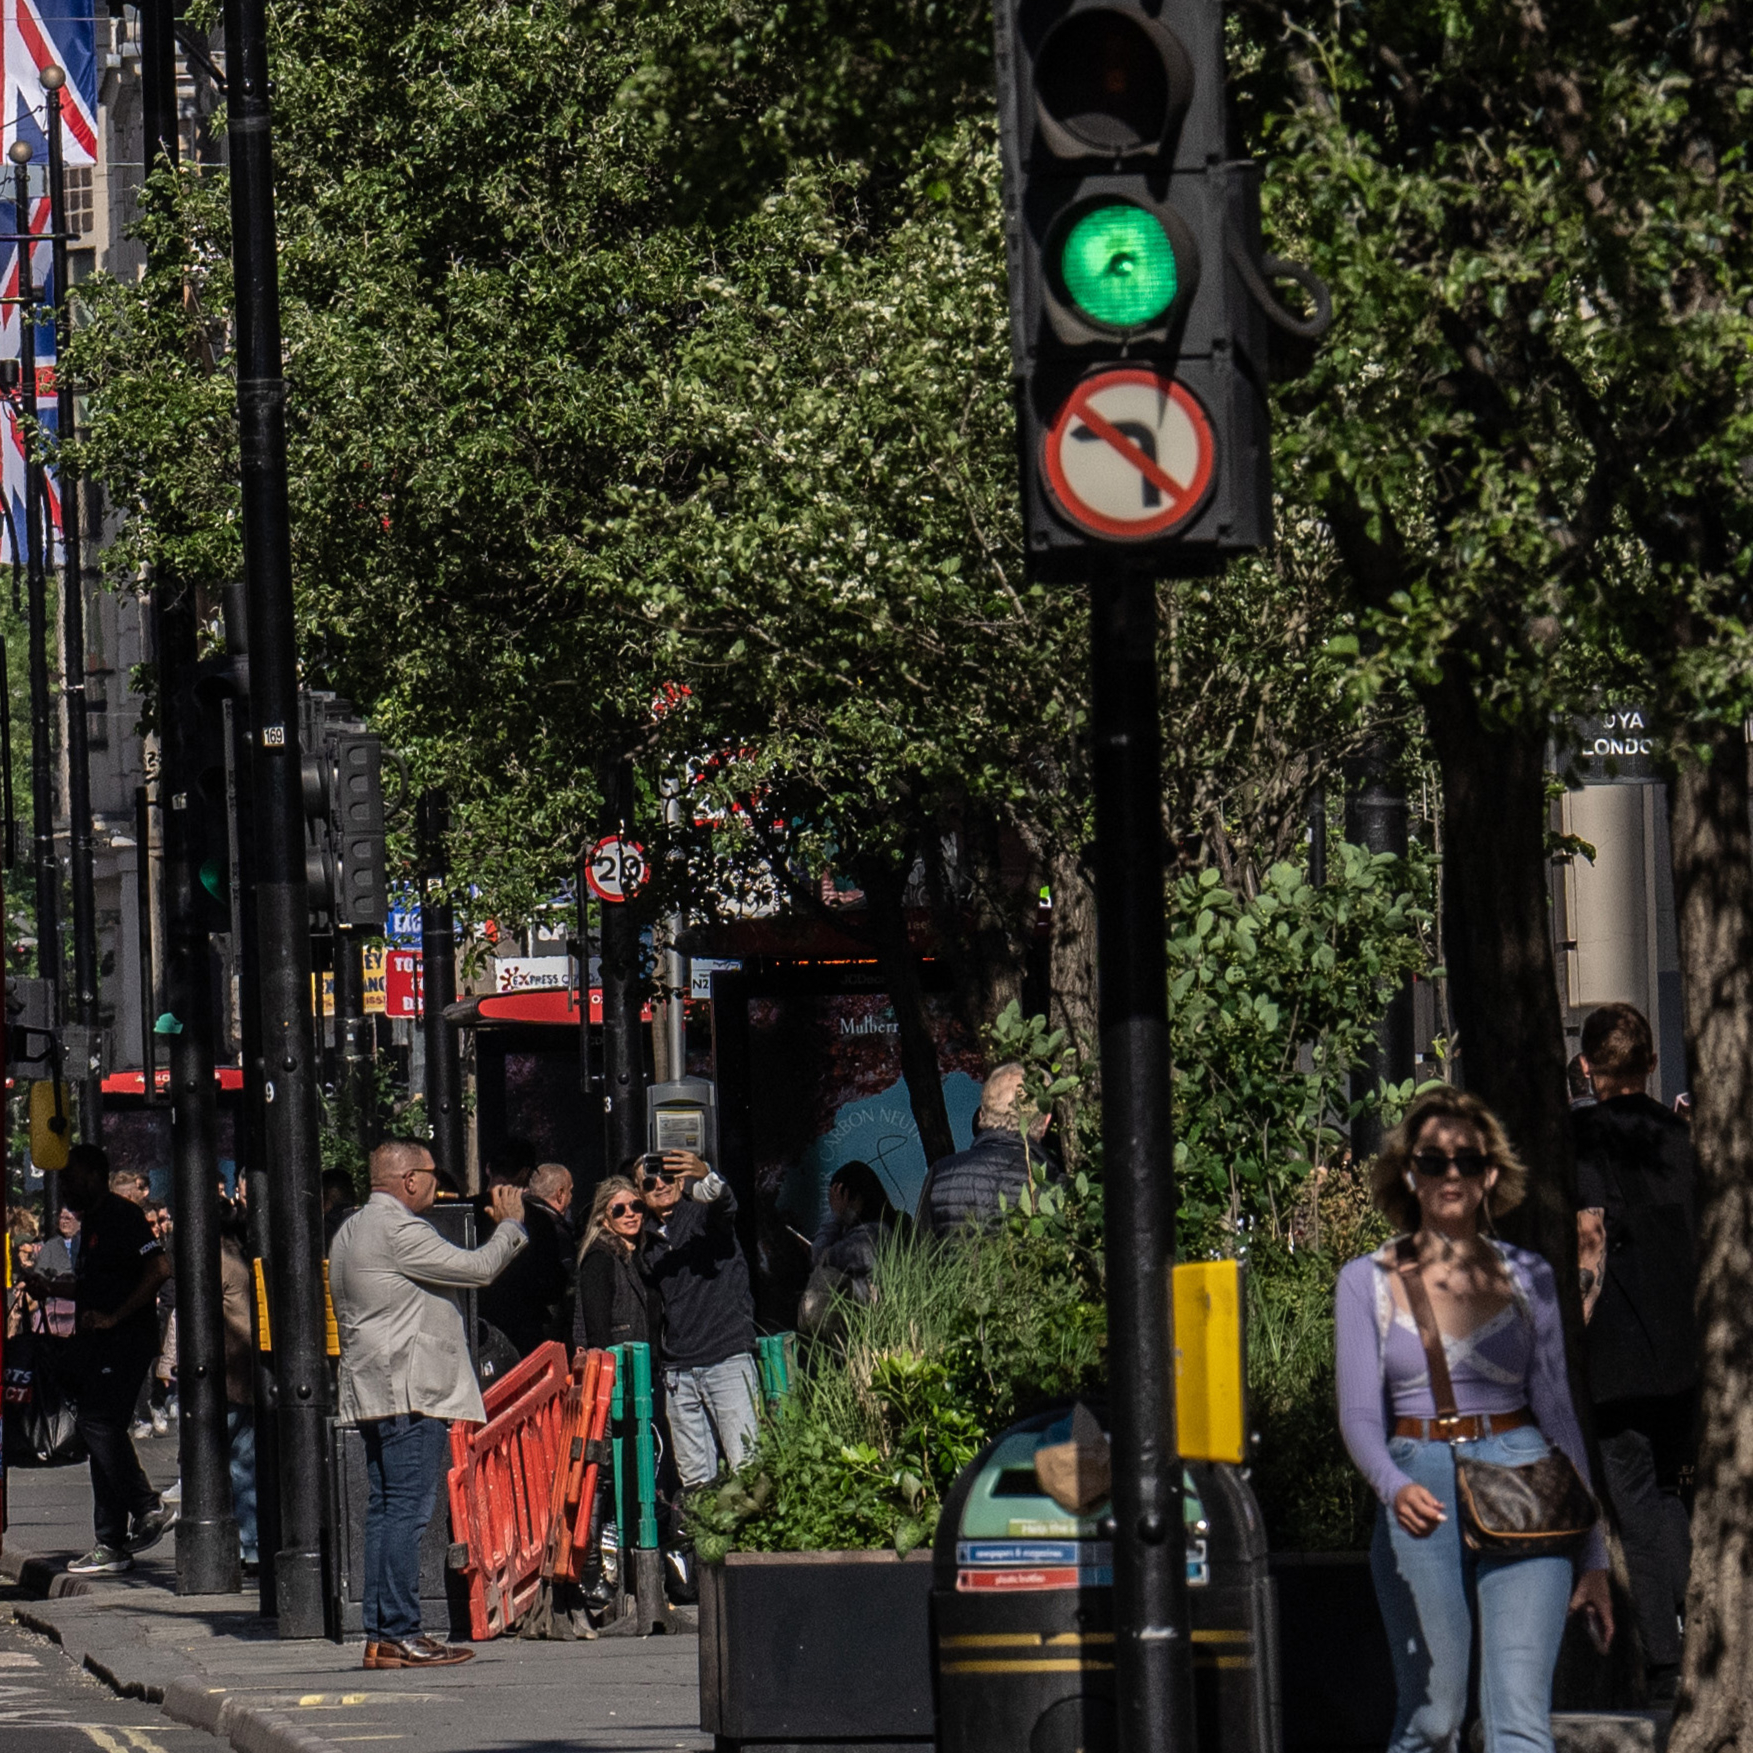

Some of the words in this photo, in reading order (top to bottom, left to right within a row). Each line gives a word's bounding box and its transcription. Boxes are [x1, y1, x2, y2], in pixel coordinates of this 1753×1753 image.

[266, 728, 283, 744] 169
[596, 855, 642, 883] 20
[840, 1014, 901, 1036] Mulberr
[819, 1107, 875, 1162] CARBON
